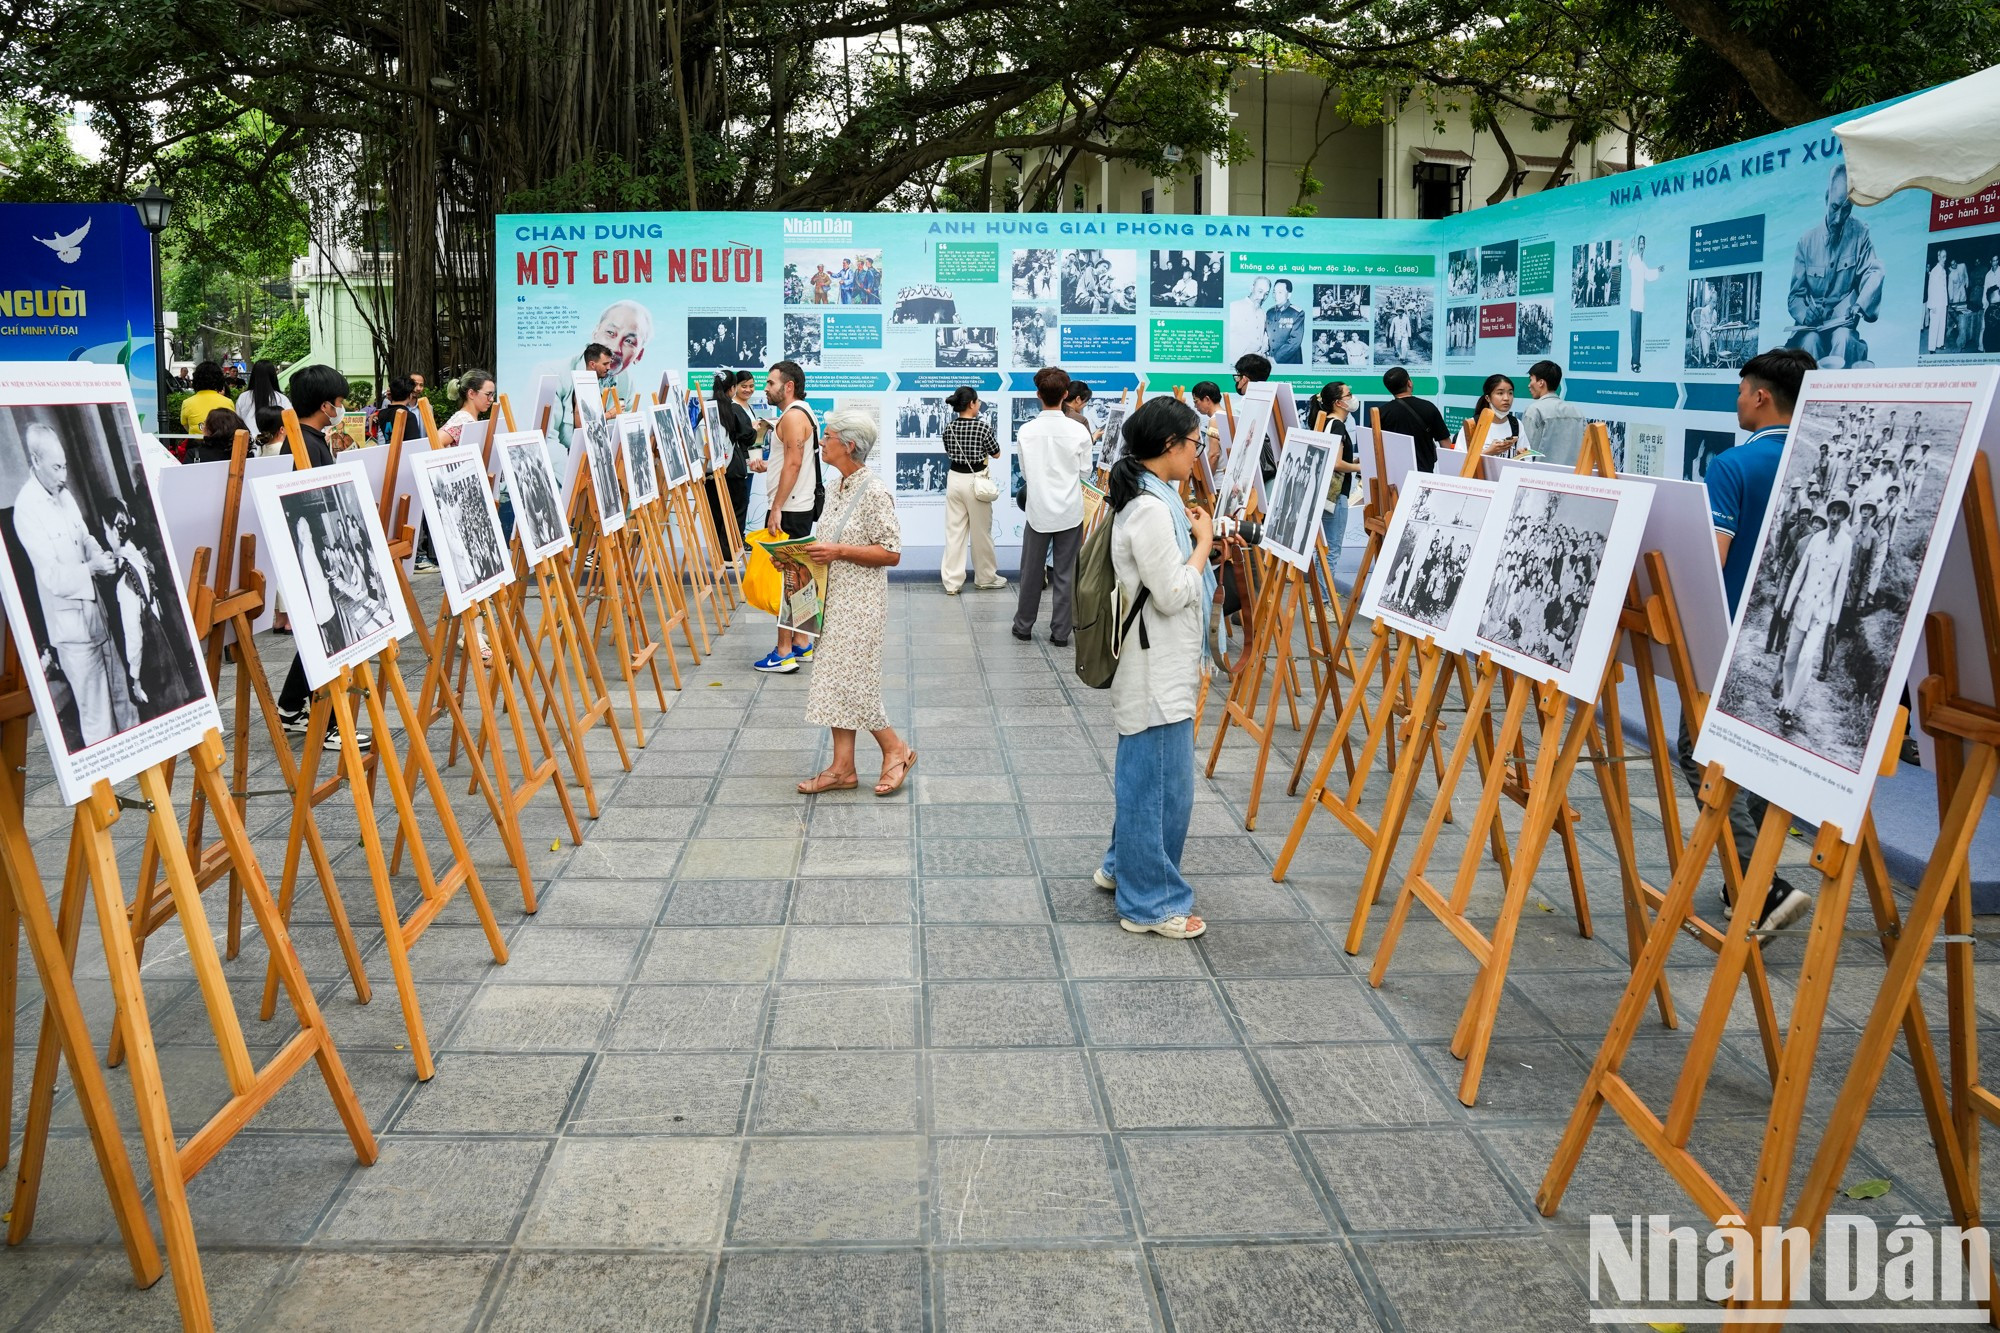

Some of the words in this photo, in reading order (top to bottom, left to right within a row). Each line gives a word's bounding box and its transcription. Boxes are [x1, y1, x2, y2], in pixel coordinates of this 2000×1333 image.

[1939, 213, 1953, 223] học
[595, 224, 663, 240] DUNG
[928, 221, 976, 234] ANH
[517, 245, 578, 288] MỘT
[593, 249, 652, 284] CON
[669, 240, 763, 283] NGƯỜI
[1240, 263, 1262, 272] Không
[1, 323, 19, 335] CHÍ
[21, 326, 46, 335] MINH
[48, 325, 59, 335] VĨ
[60, 326, 78, 337] ĐẠI
